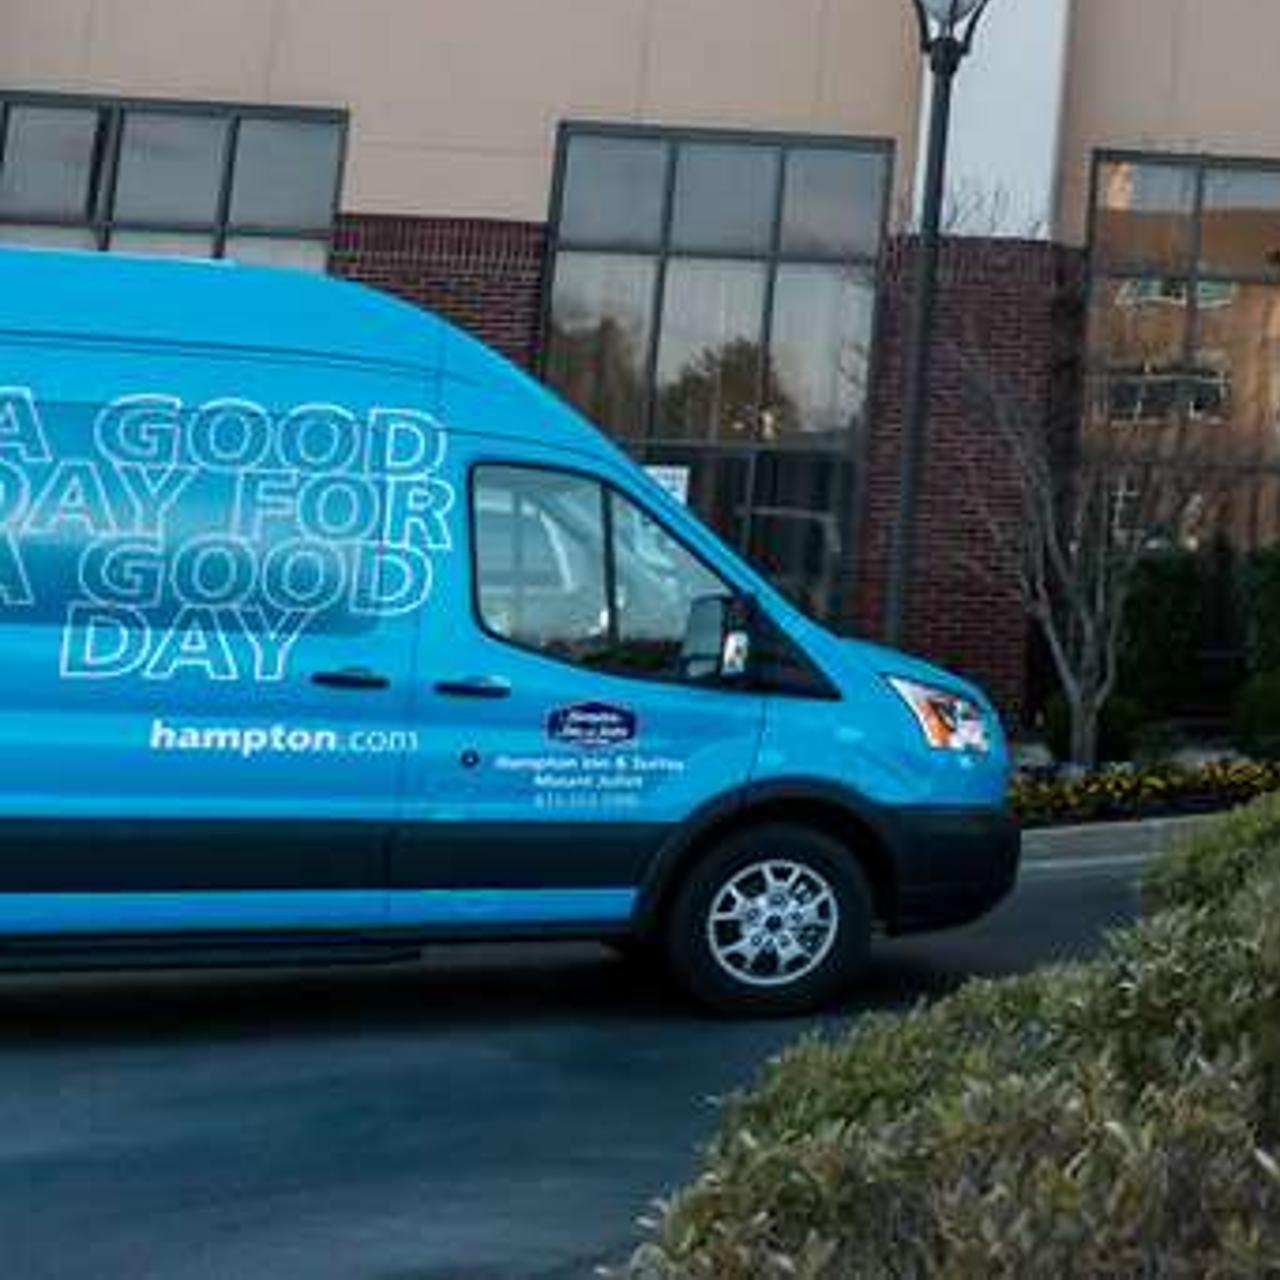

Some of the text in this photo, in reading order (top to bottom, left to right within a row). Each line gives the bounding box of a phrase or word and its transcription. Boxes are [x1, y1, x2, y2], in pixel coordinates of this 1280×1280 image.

[93, 392, 448, 480] GOOD
[232, 471, 456, 550] FOR
[78, 532, 434, 616] GOOD
[60, 602, 317, 681] DAY
[149, 718, 419, 758] hampton.com
